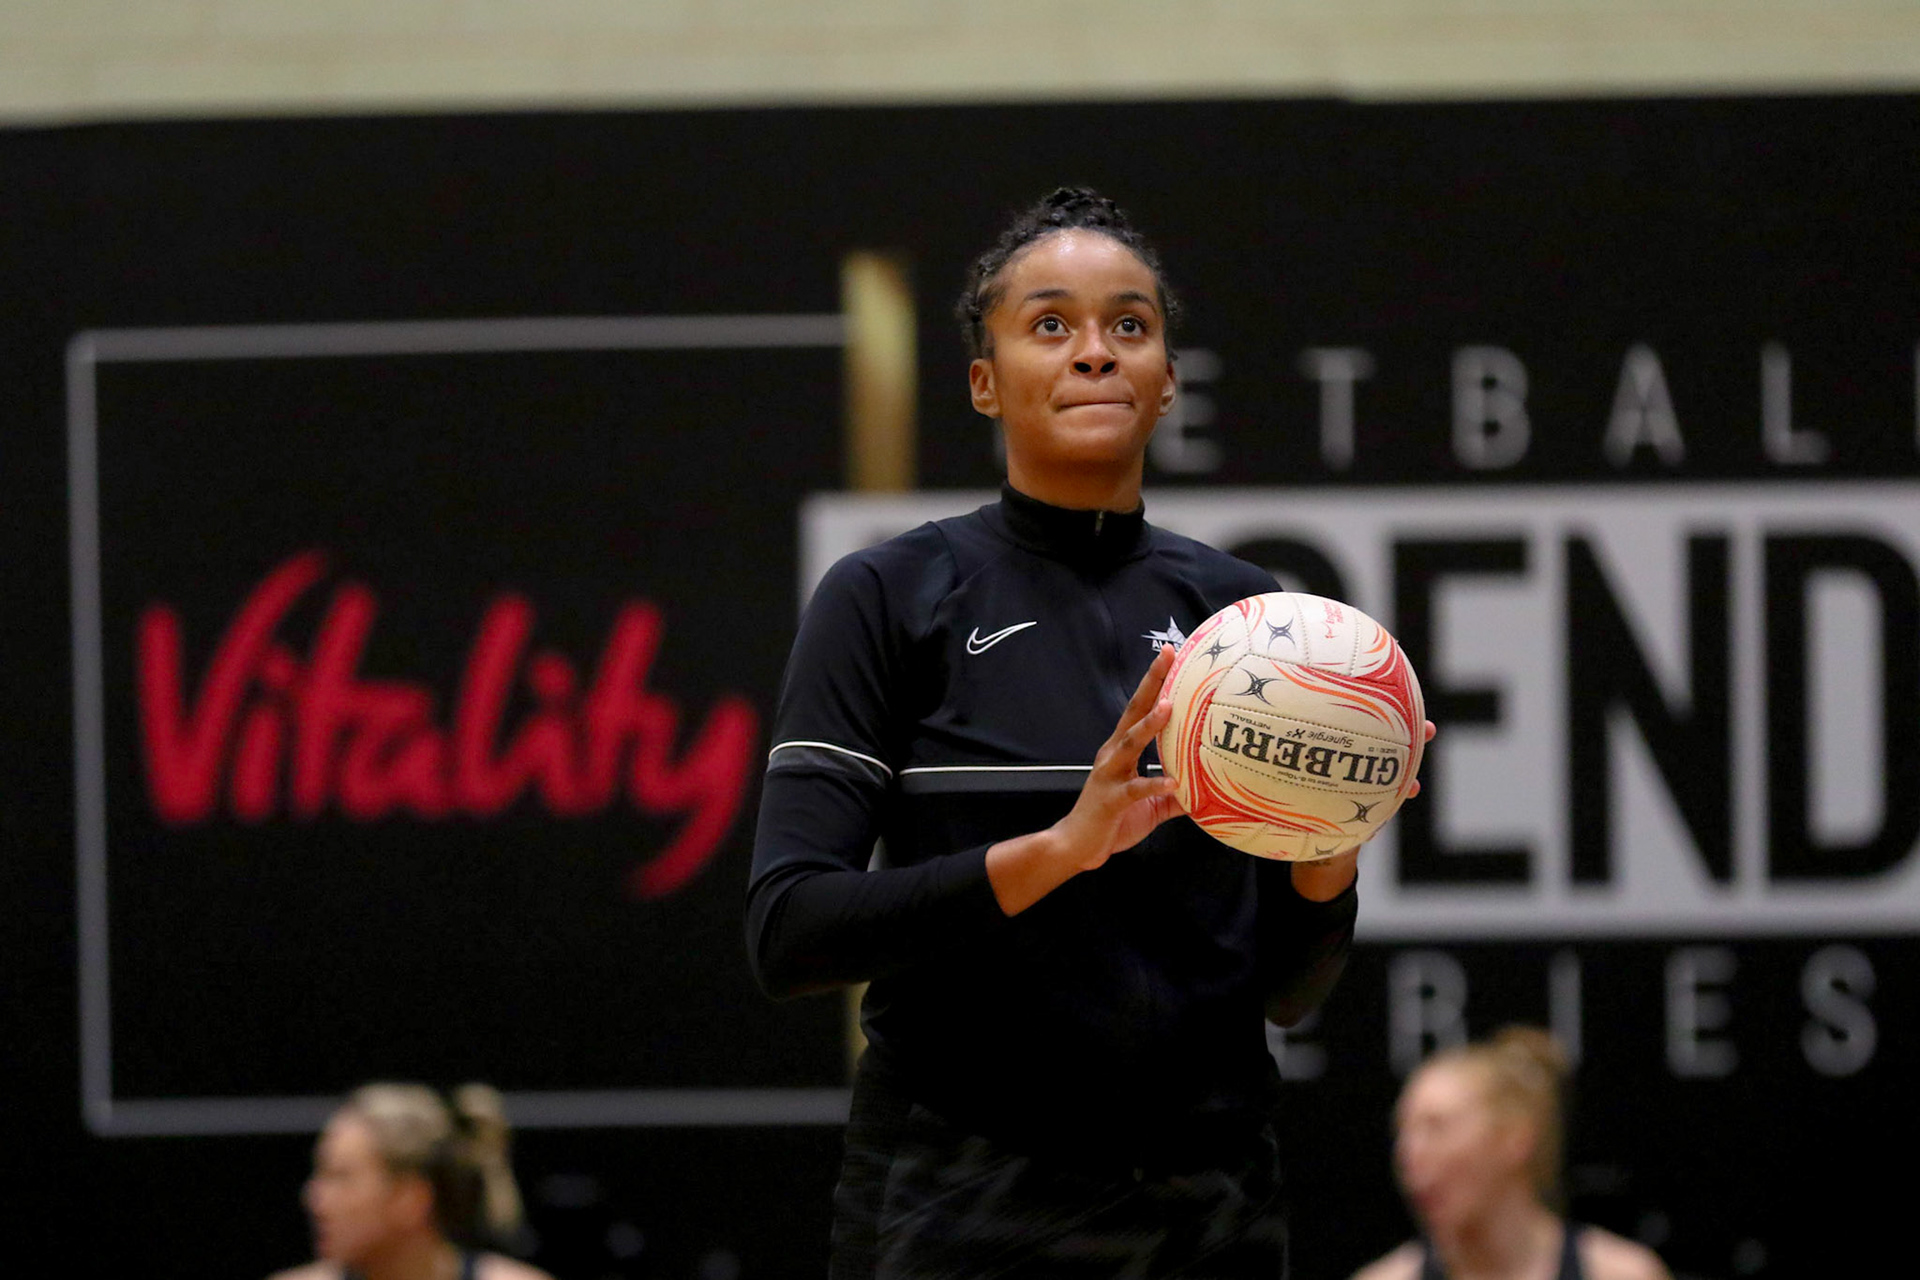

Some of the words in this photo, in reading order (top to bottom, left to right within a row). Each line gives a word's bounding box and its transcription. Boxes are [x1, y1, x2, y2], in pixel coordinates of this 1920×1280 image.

[992, 340, 1920, 474] ETBAL
[138, 550, 757, 897] Vitality
[1213, 720, 1400, 787] GILBERT
[1230, 712, 1271, 731] NETBALL
[1266, 944, 1878, 1080] RIES
